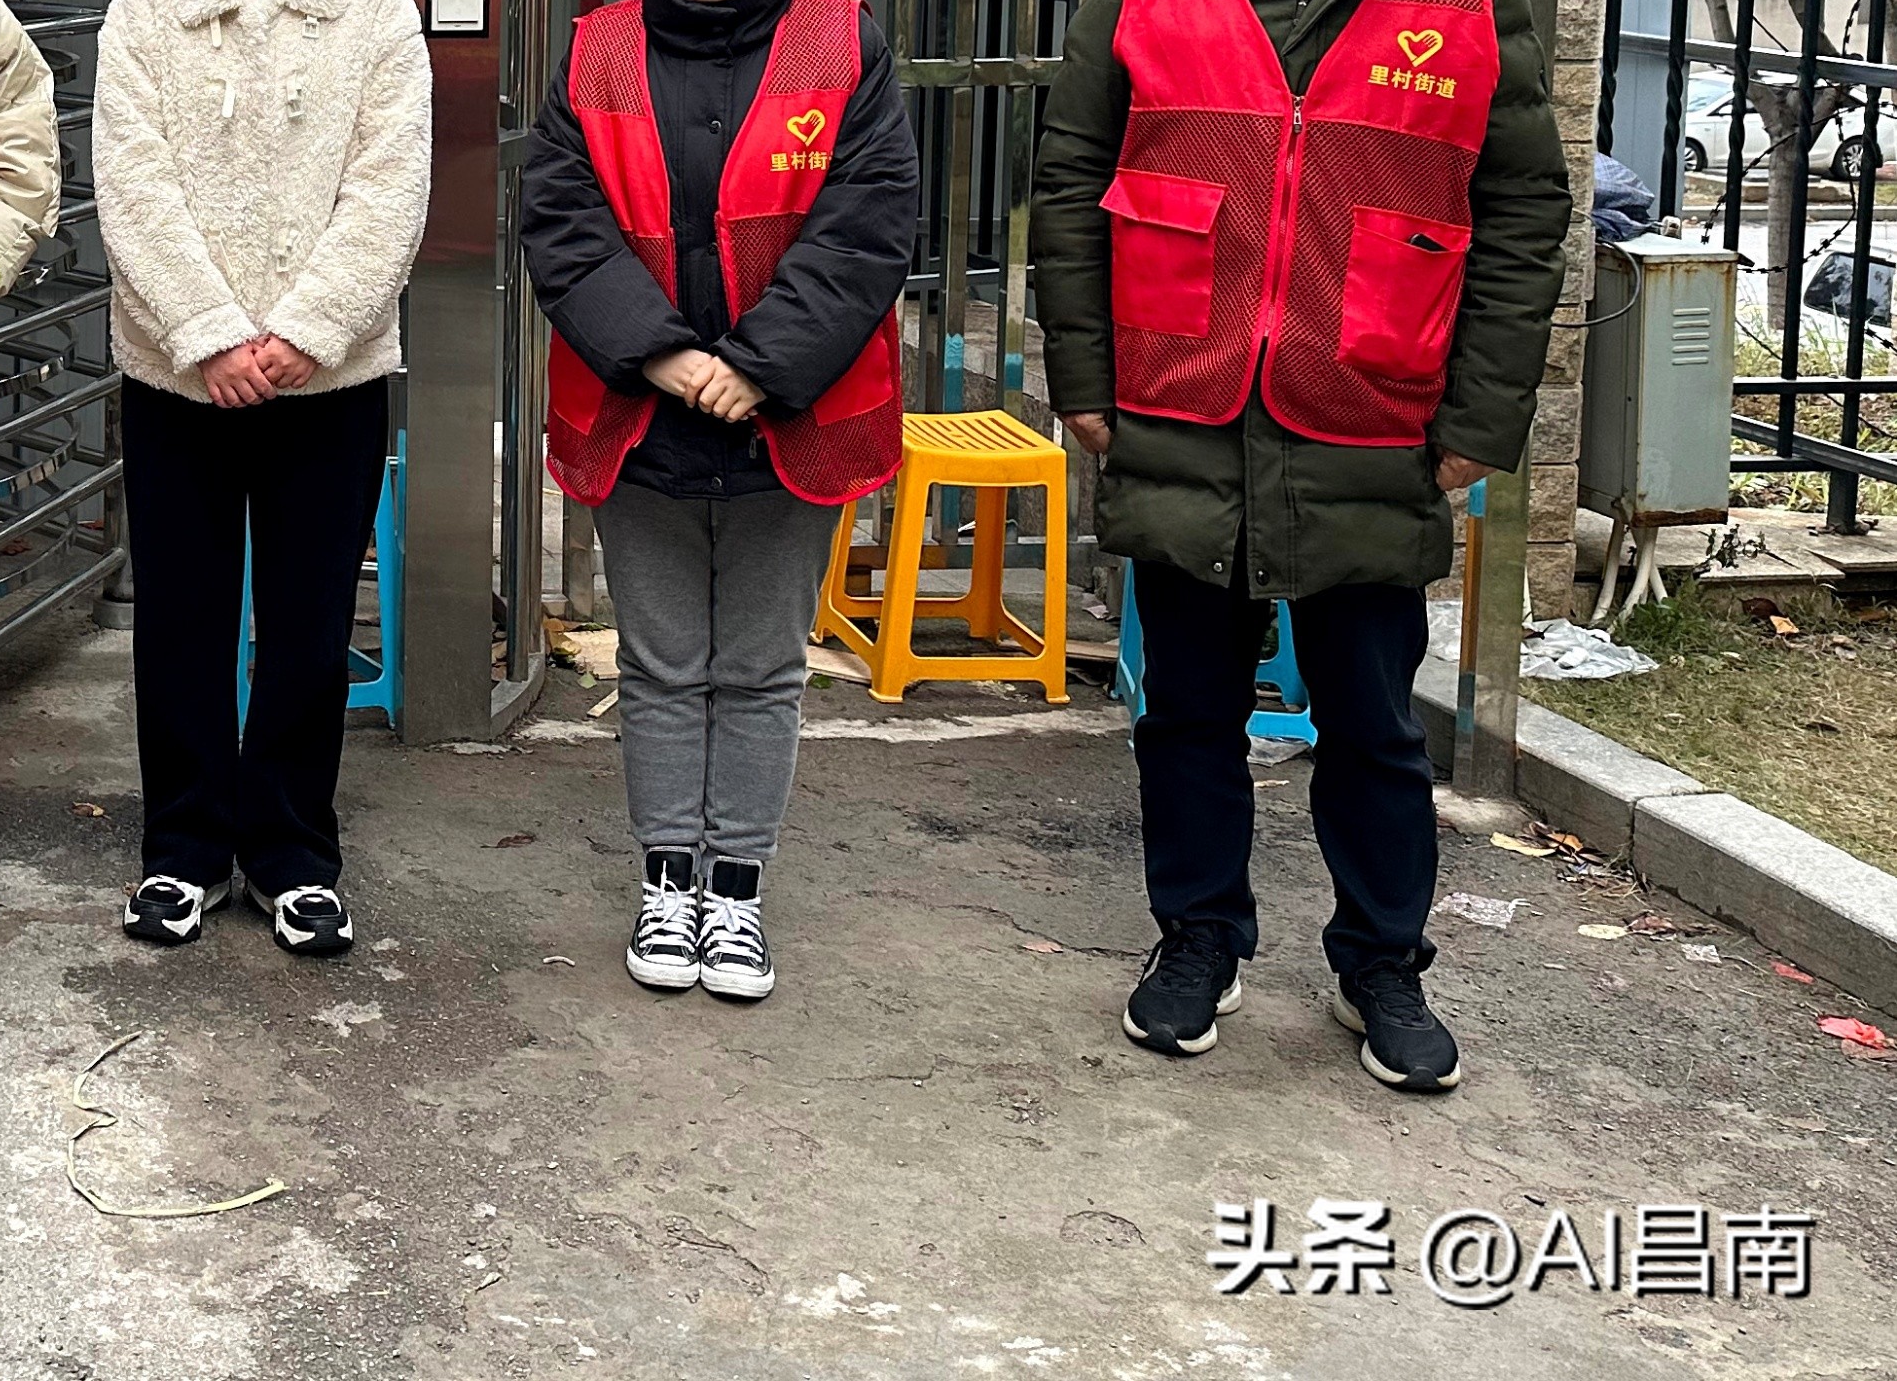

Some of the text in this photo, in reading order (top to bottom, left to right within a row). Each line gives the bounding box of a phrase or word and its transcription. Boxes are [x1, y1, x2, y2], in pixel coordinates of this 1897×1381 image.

[1367, 64, 1457, 99] 里村街道
[770, 150, 833, 172] 里村街
